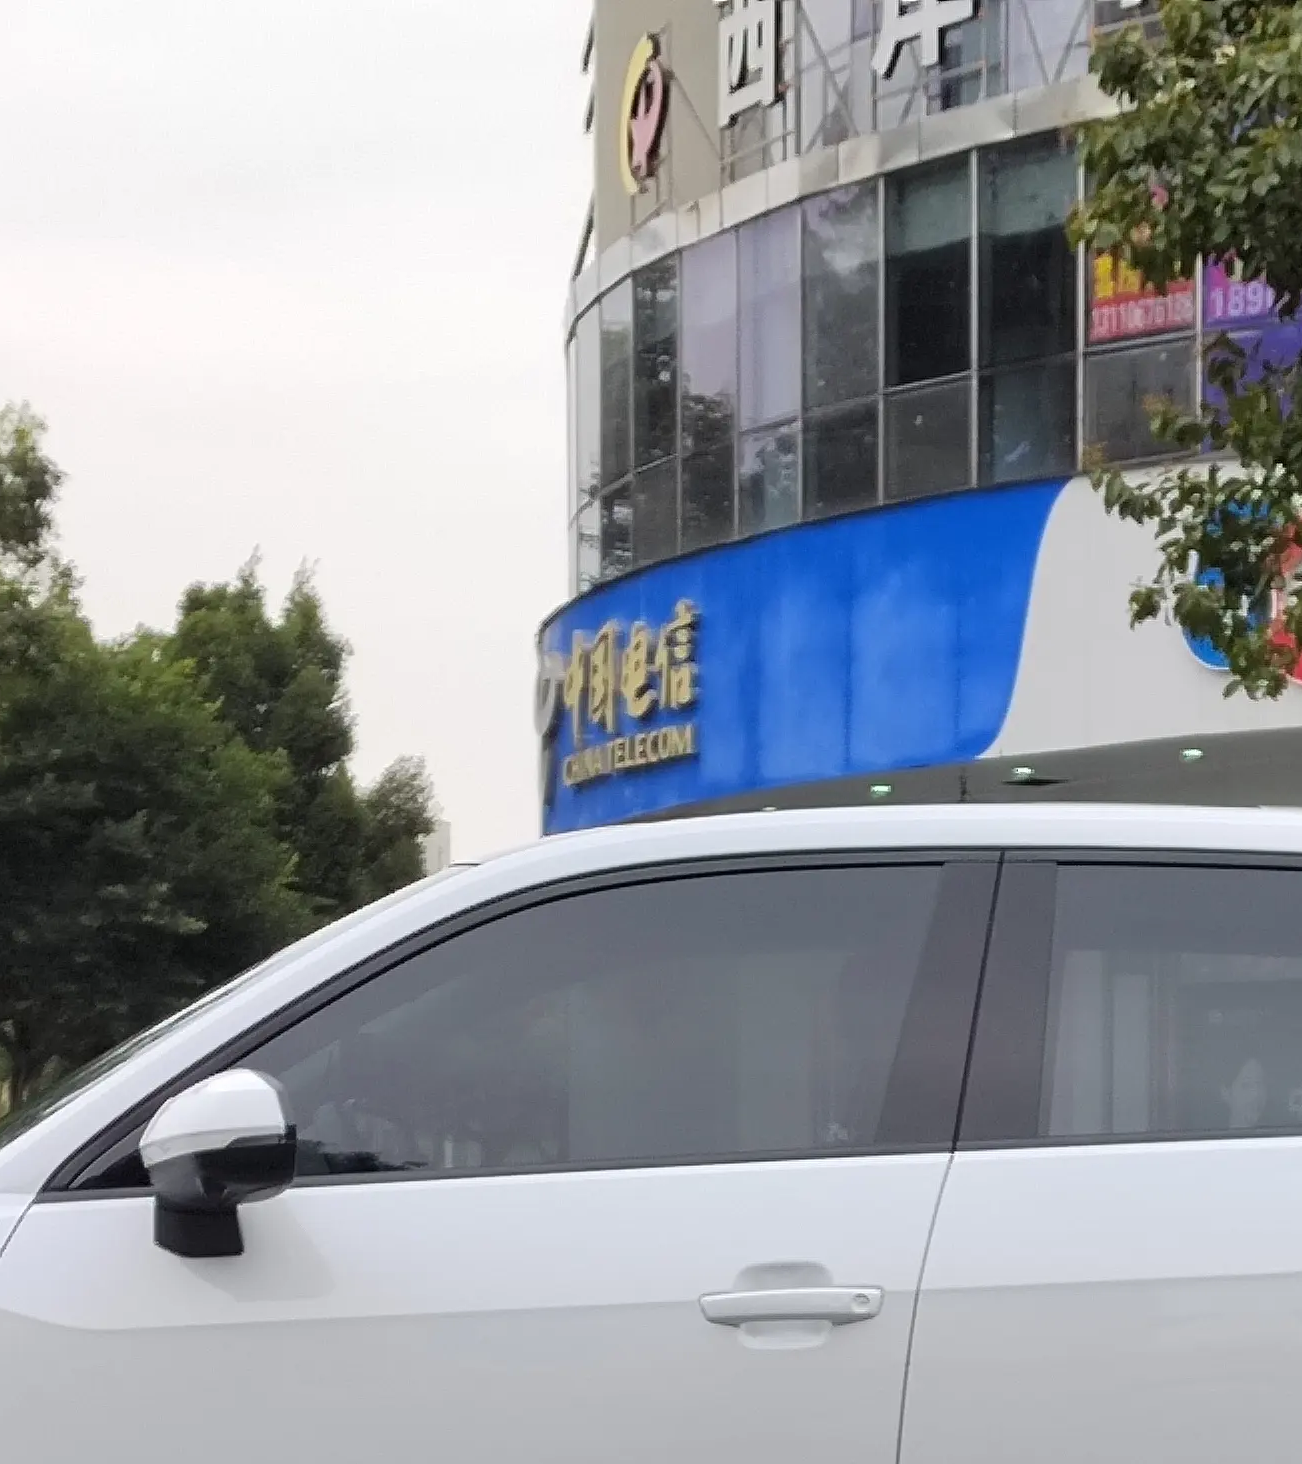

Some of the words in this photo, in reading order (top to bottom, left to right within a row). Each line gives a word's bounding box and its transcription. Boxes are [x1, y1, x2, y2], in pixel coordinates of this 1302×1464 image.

[563, 598, 698, 746] 中国电信
[605, 723, 695, 775] TELECOM
